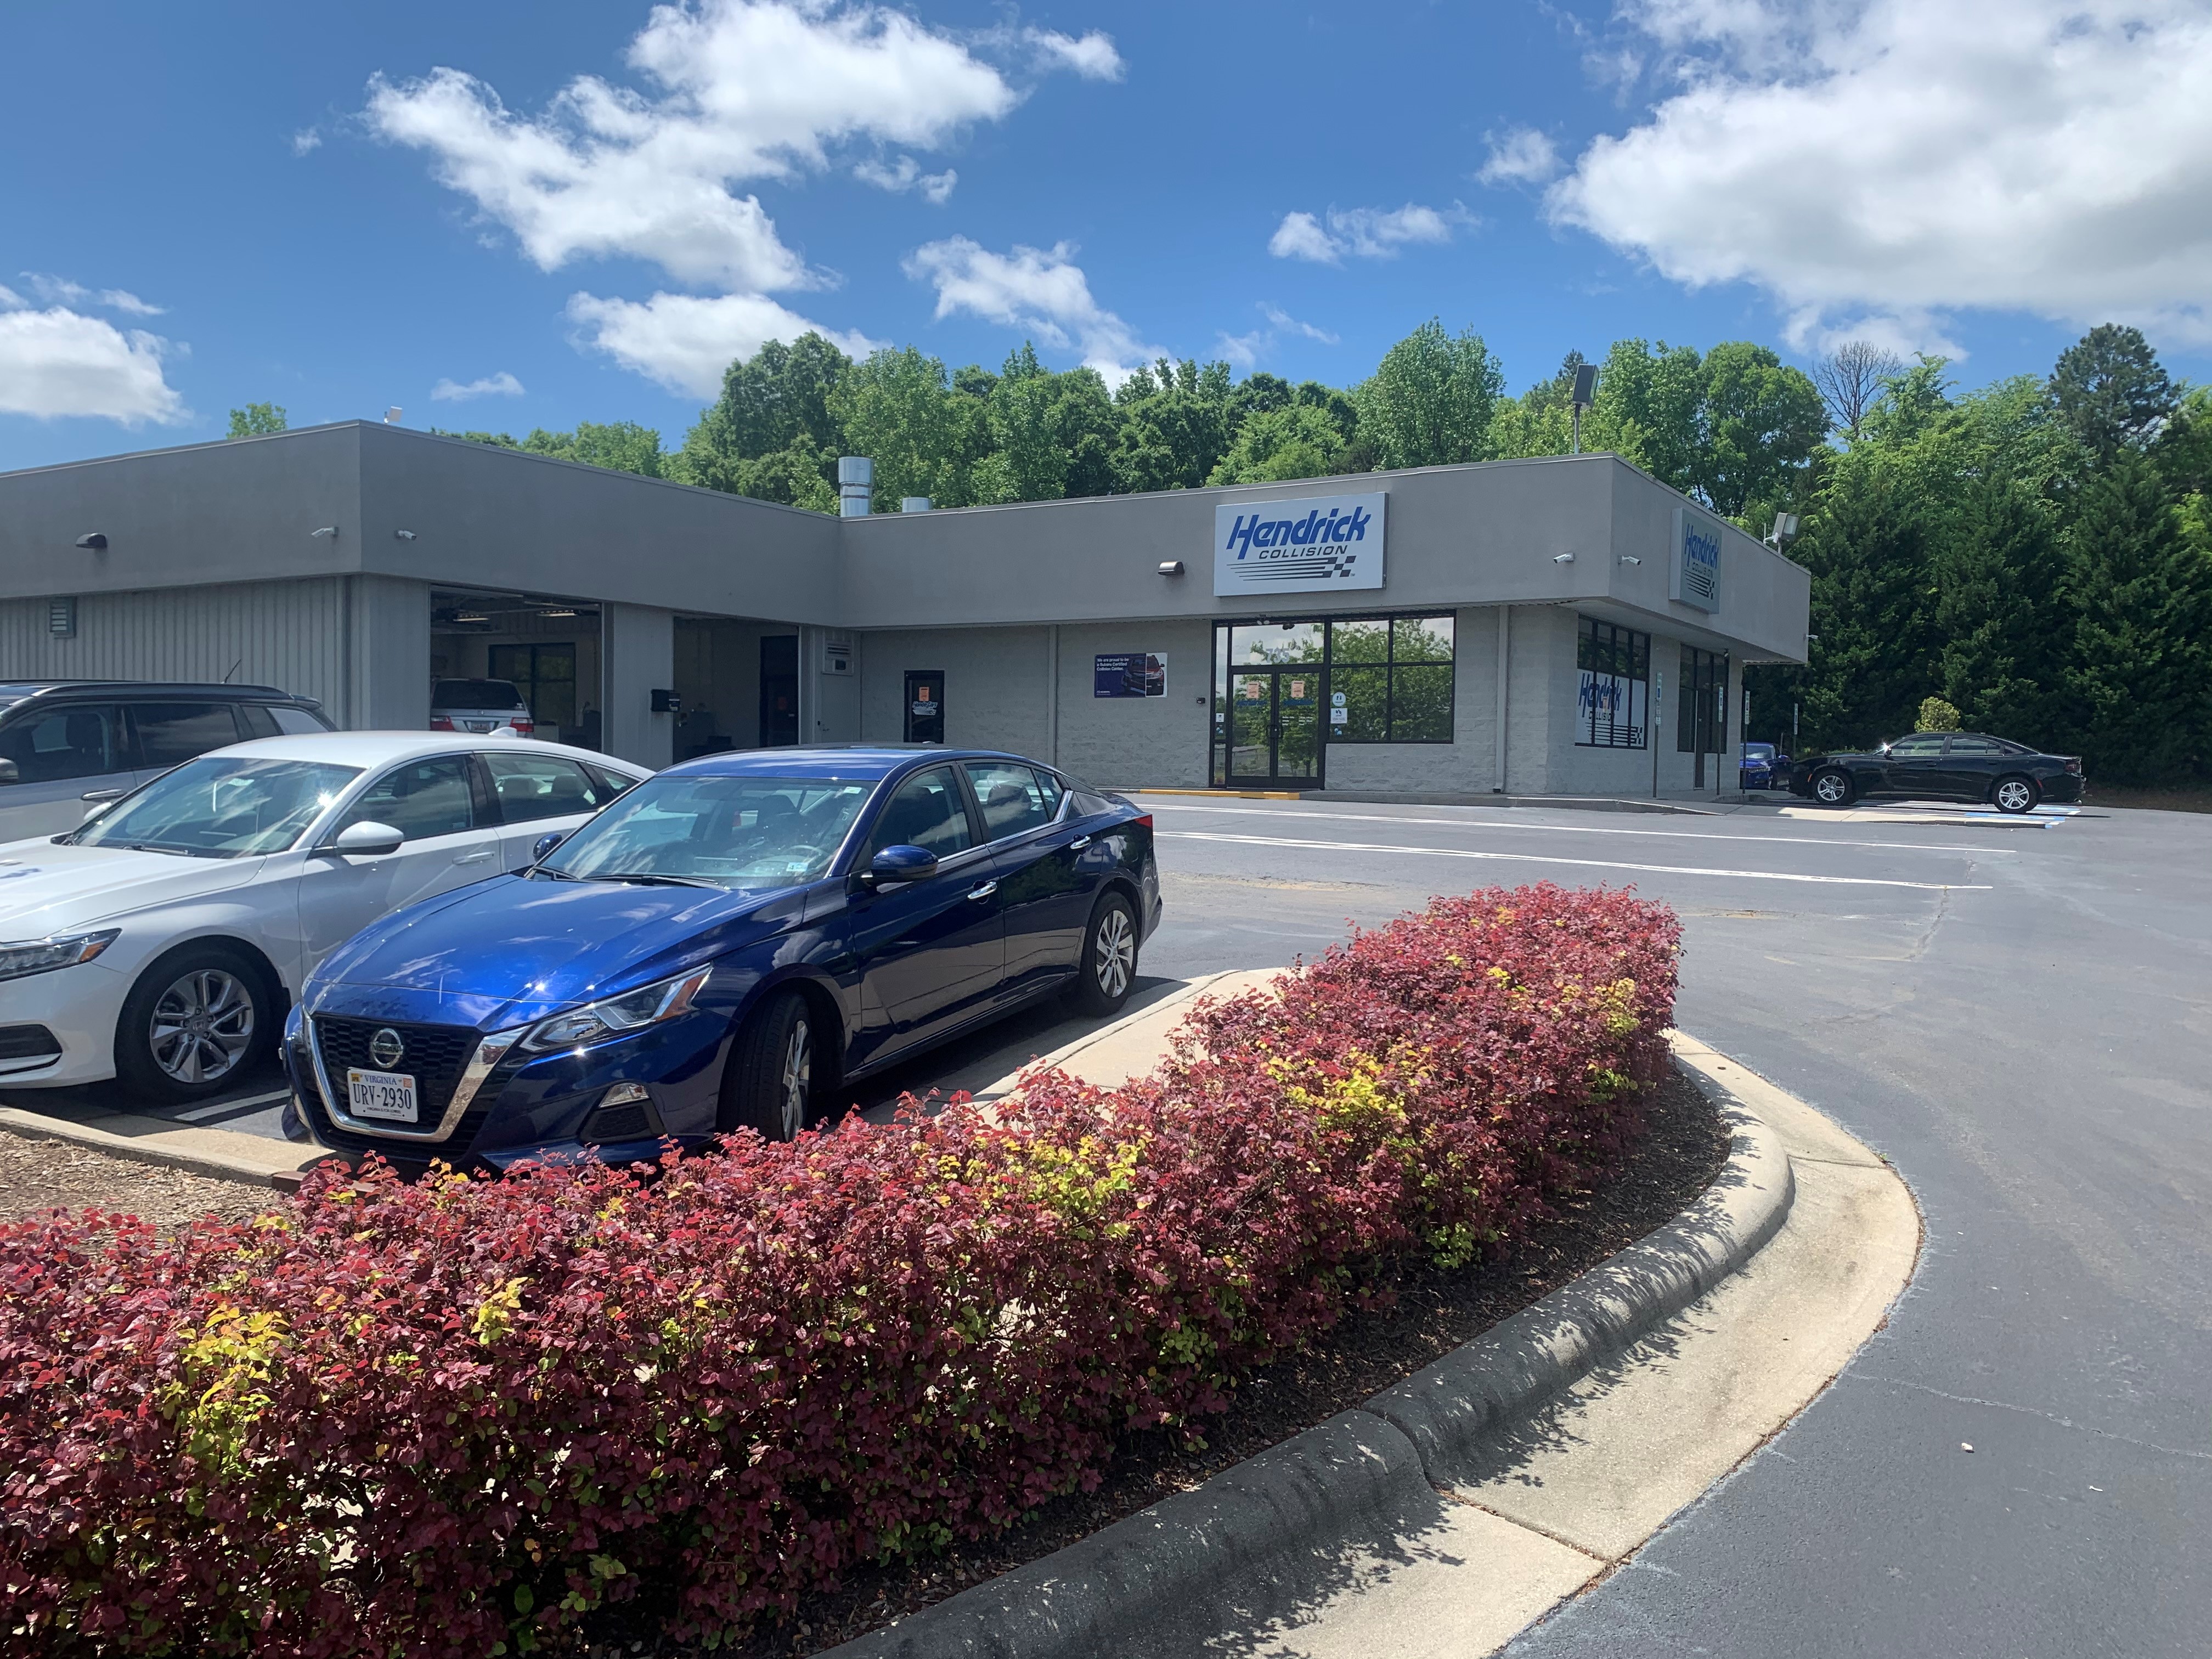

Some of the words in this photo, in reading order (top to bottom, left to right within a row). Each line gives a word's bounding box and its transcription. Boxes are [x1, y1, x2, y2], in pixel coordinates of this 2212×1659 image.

[1226, 506, 1372, 560] Hendrick
[1259, 545, 1348, 560] COLLISION
[1684, 523, 1719, 569] Hendrick
[1266, 647, 1289, 663] 735
[364, 1075, 397, 1085] VIRGINIA
[353, 1084, 411, 1109] URV-2930
